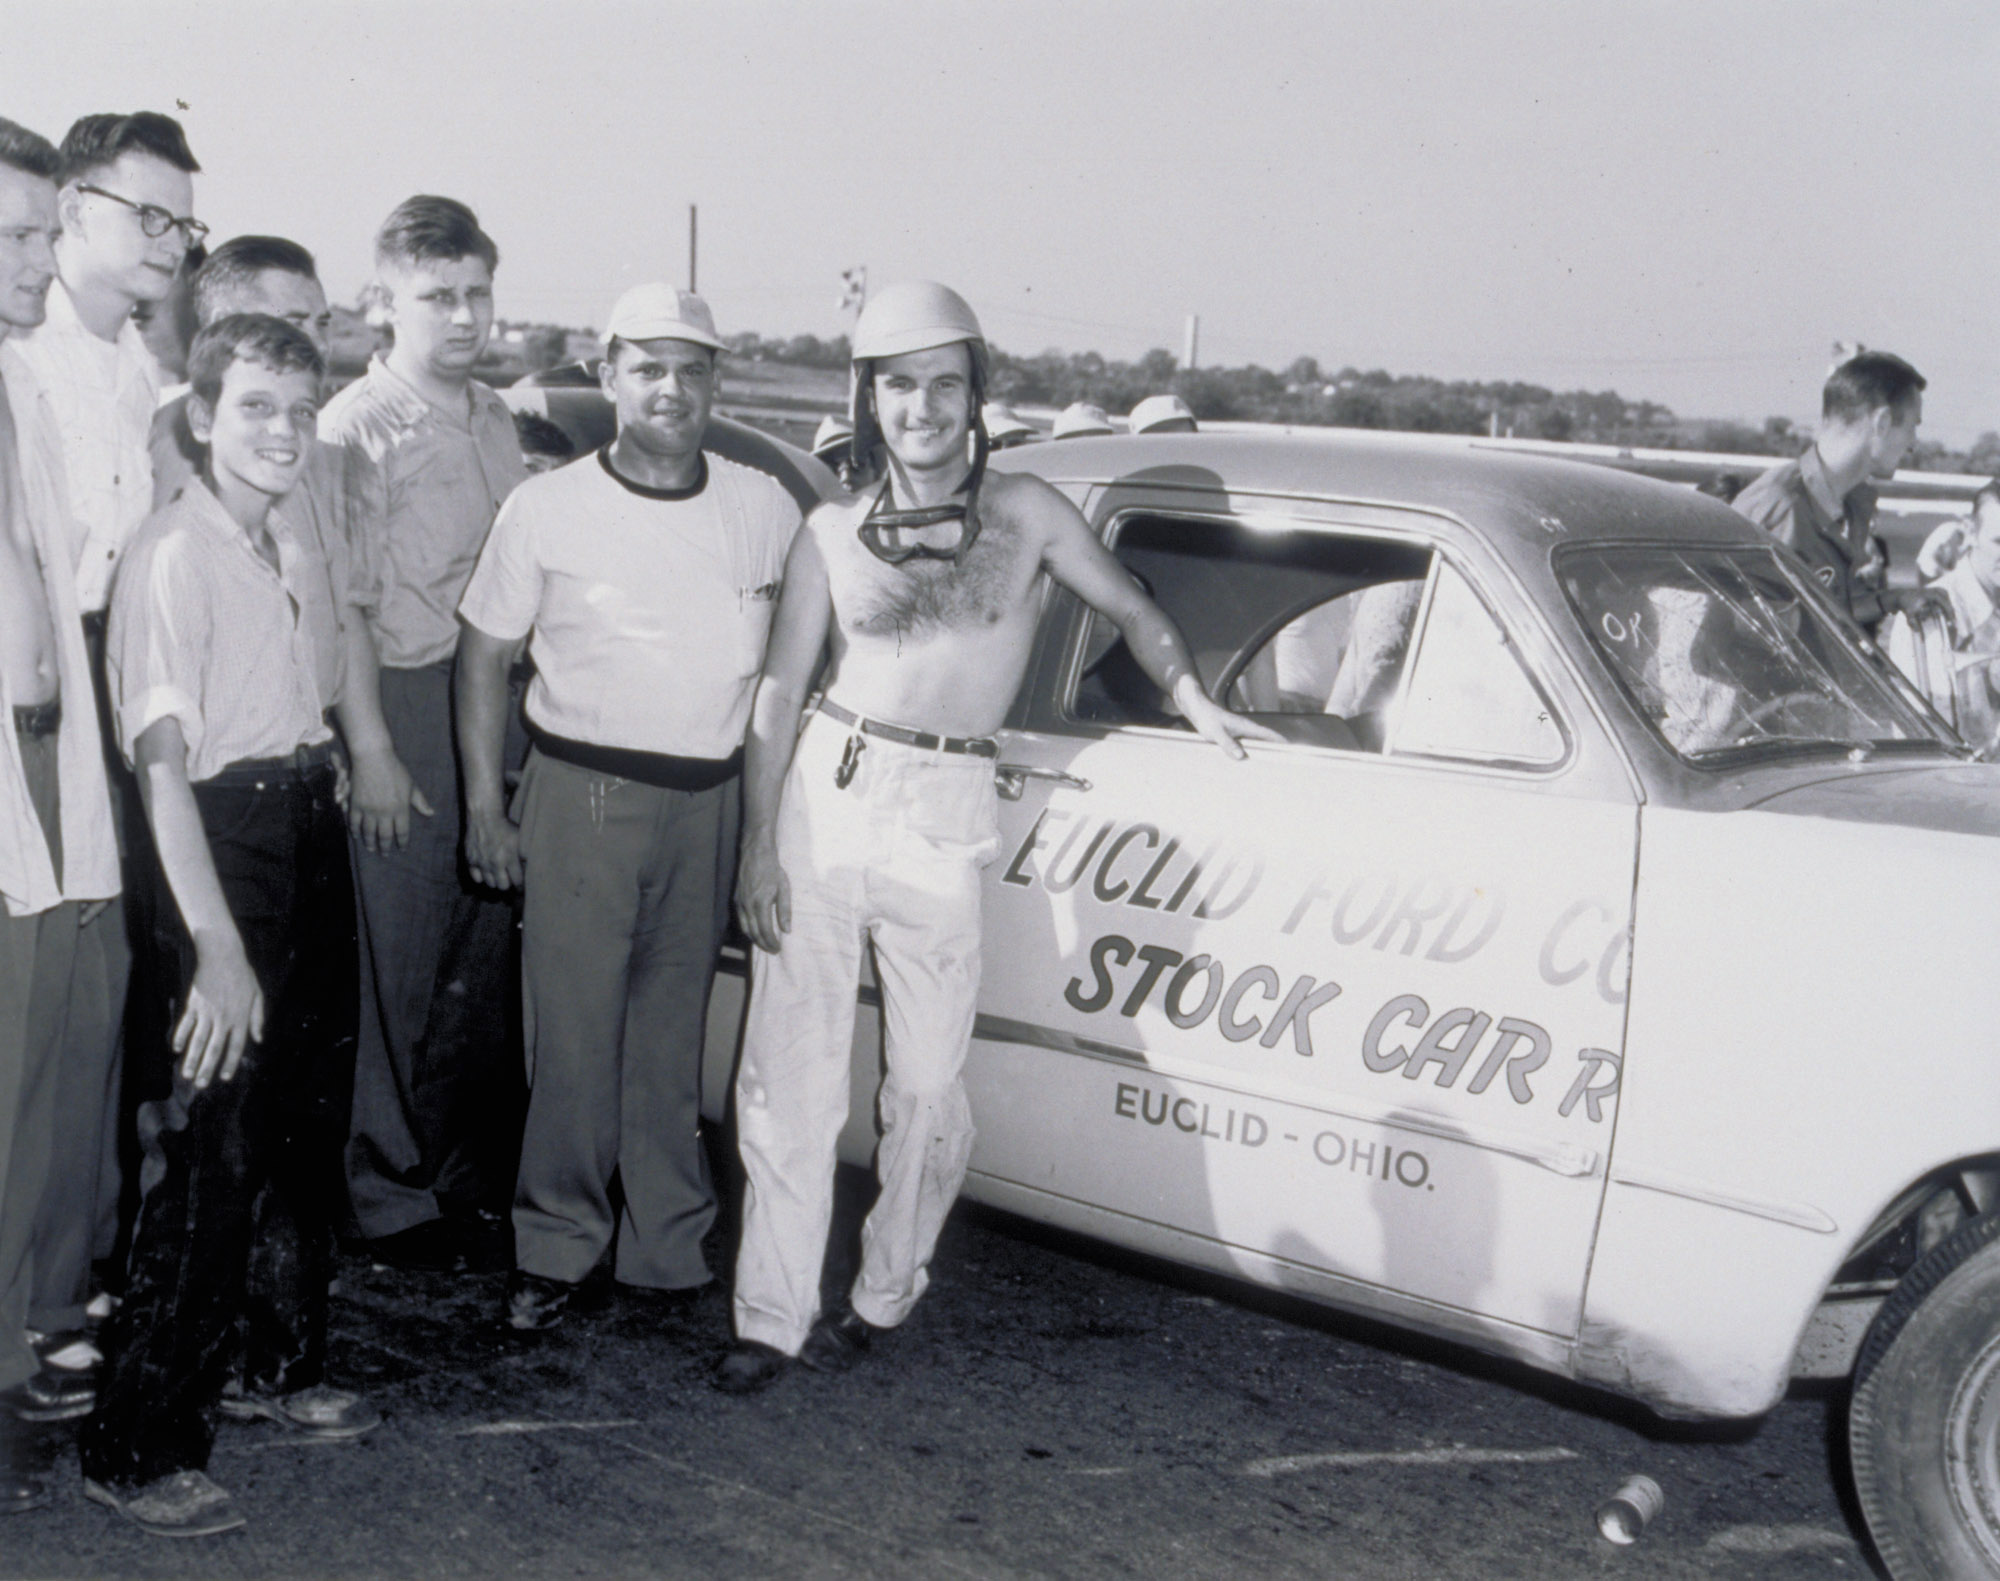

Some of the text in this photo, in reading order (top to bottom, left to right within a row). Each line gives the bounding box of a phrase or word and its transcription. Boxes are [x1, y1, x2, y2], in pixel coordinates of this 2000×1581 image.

[1602, 611, 1648, 649] OK
[1001, 806, 1268, 921] EUCLID
[1279, 868, 1508, 963] FORD
[1063, 934, 1342, 1057] STOCK
[1362, 994, 1553, 1105] CAR
[1114, 1082, 1269, 1148] EUCLID
[1311, 1130, 1436, 1192] OHIO.
